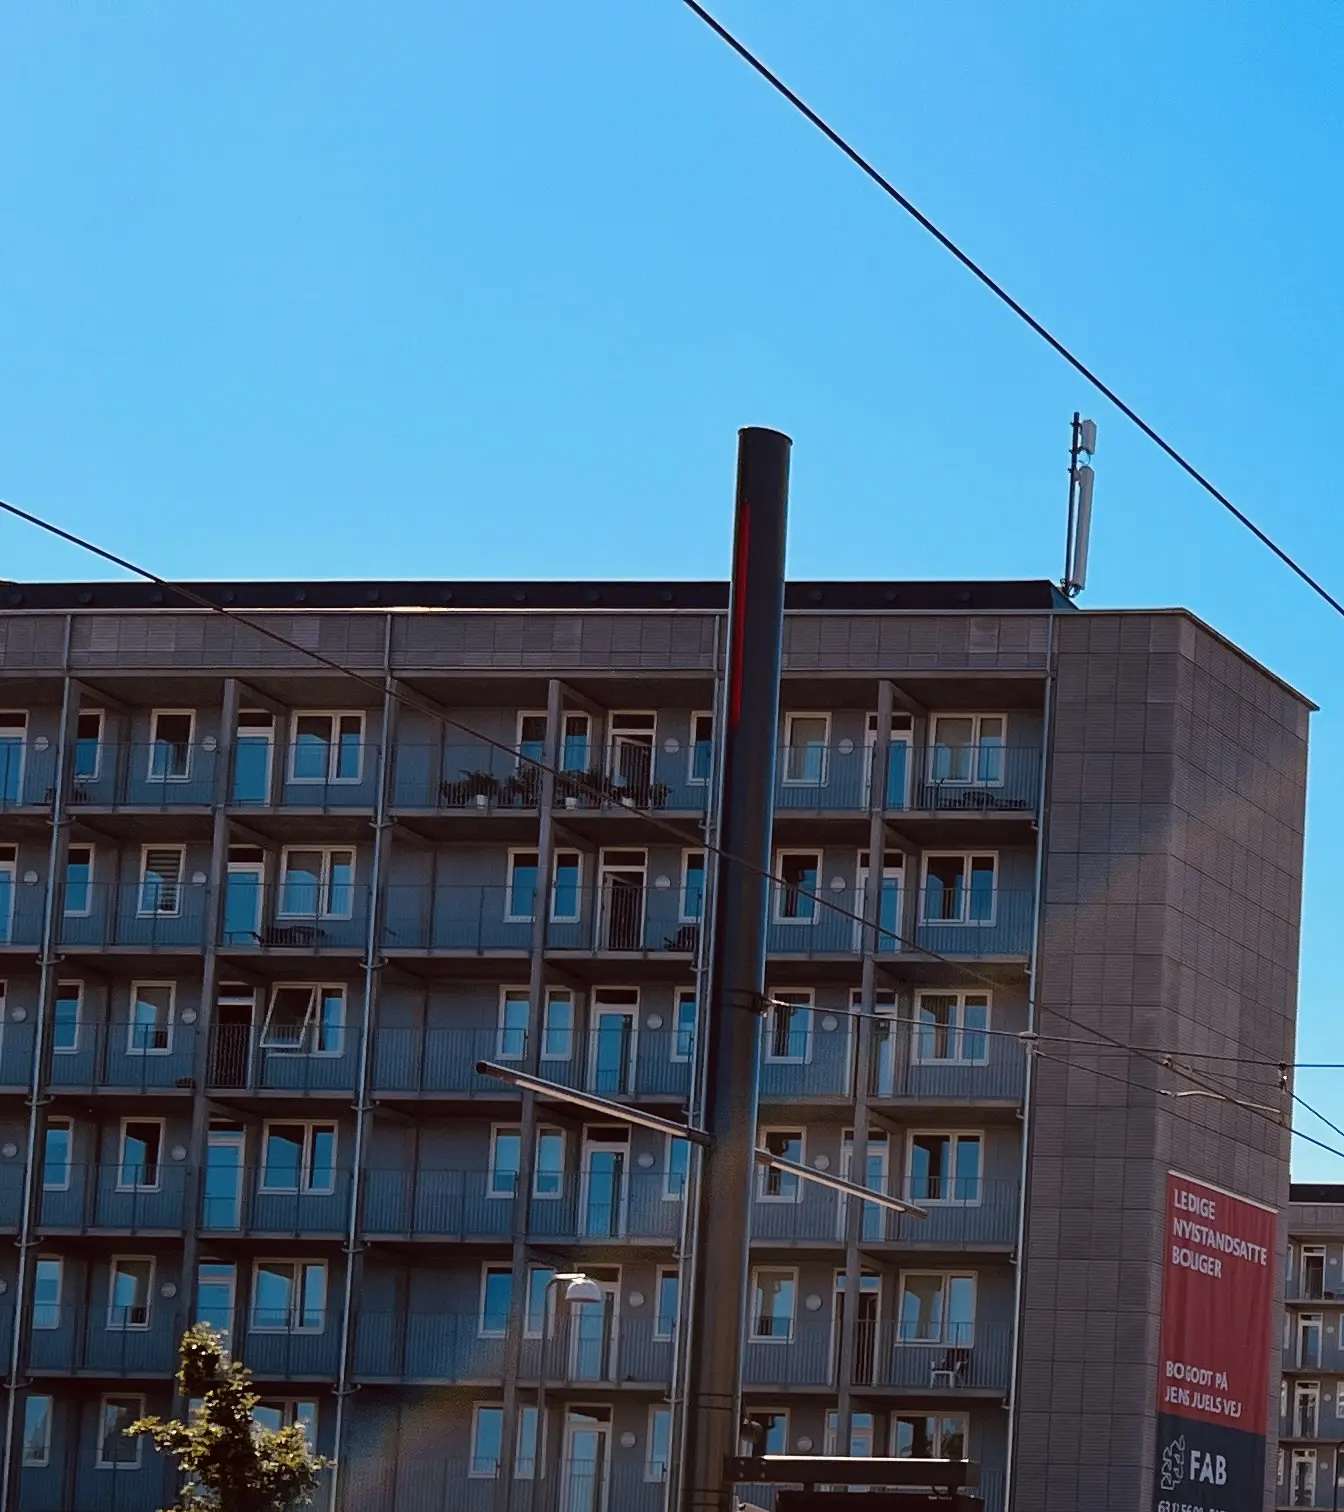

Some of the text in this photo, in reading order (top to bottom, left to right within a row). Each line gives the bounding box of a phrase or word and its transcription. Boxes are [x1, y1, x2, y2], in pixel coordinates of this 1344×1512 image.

[1173, 1188, 1216, 1220] LEDIGE
[1166, 1360, 1185, 1380] BO
[1165, 1385, 1242, 1418] JENS JUELS VEJ
[1189, 1449, 1228, 1486] FAB
